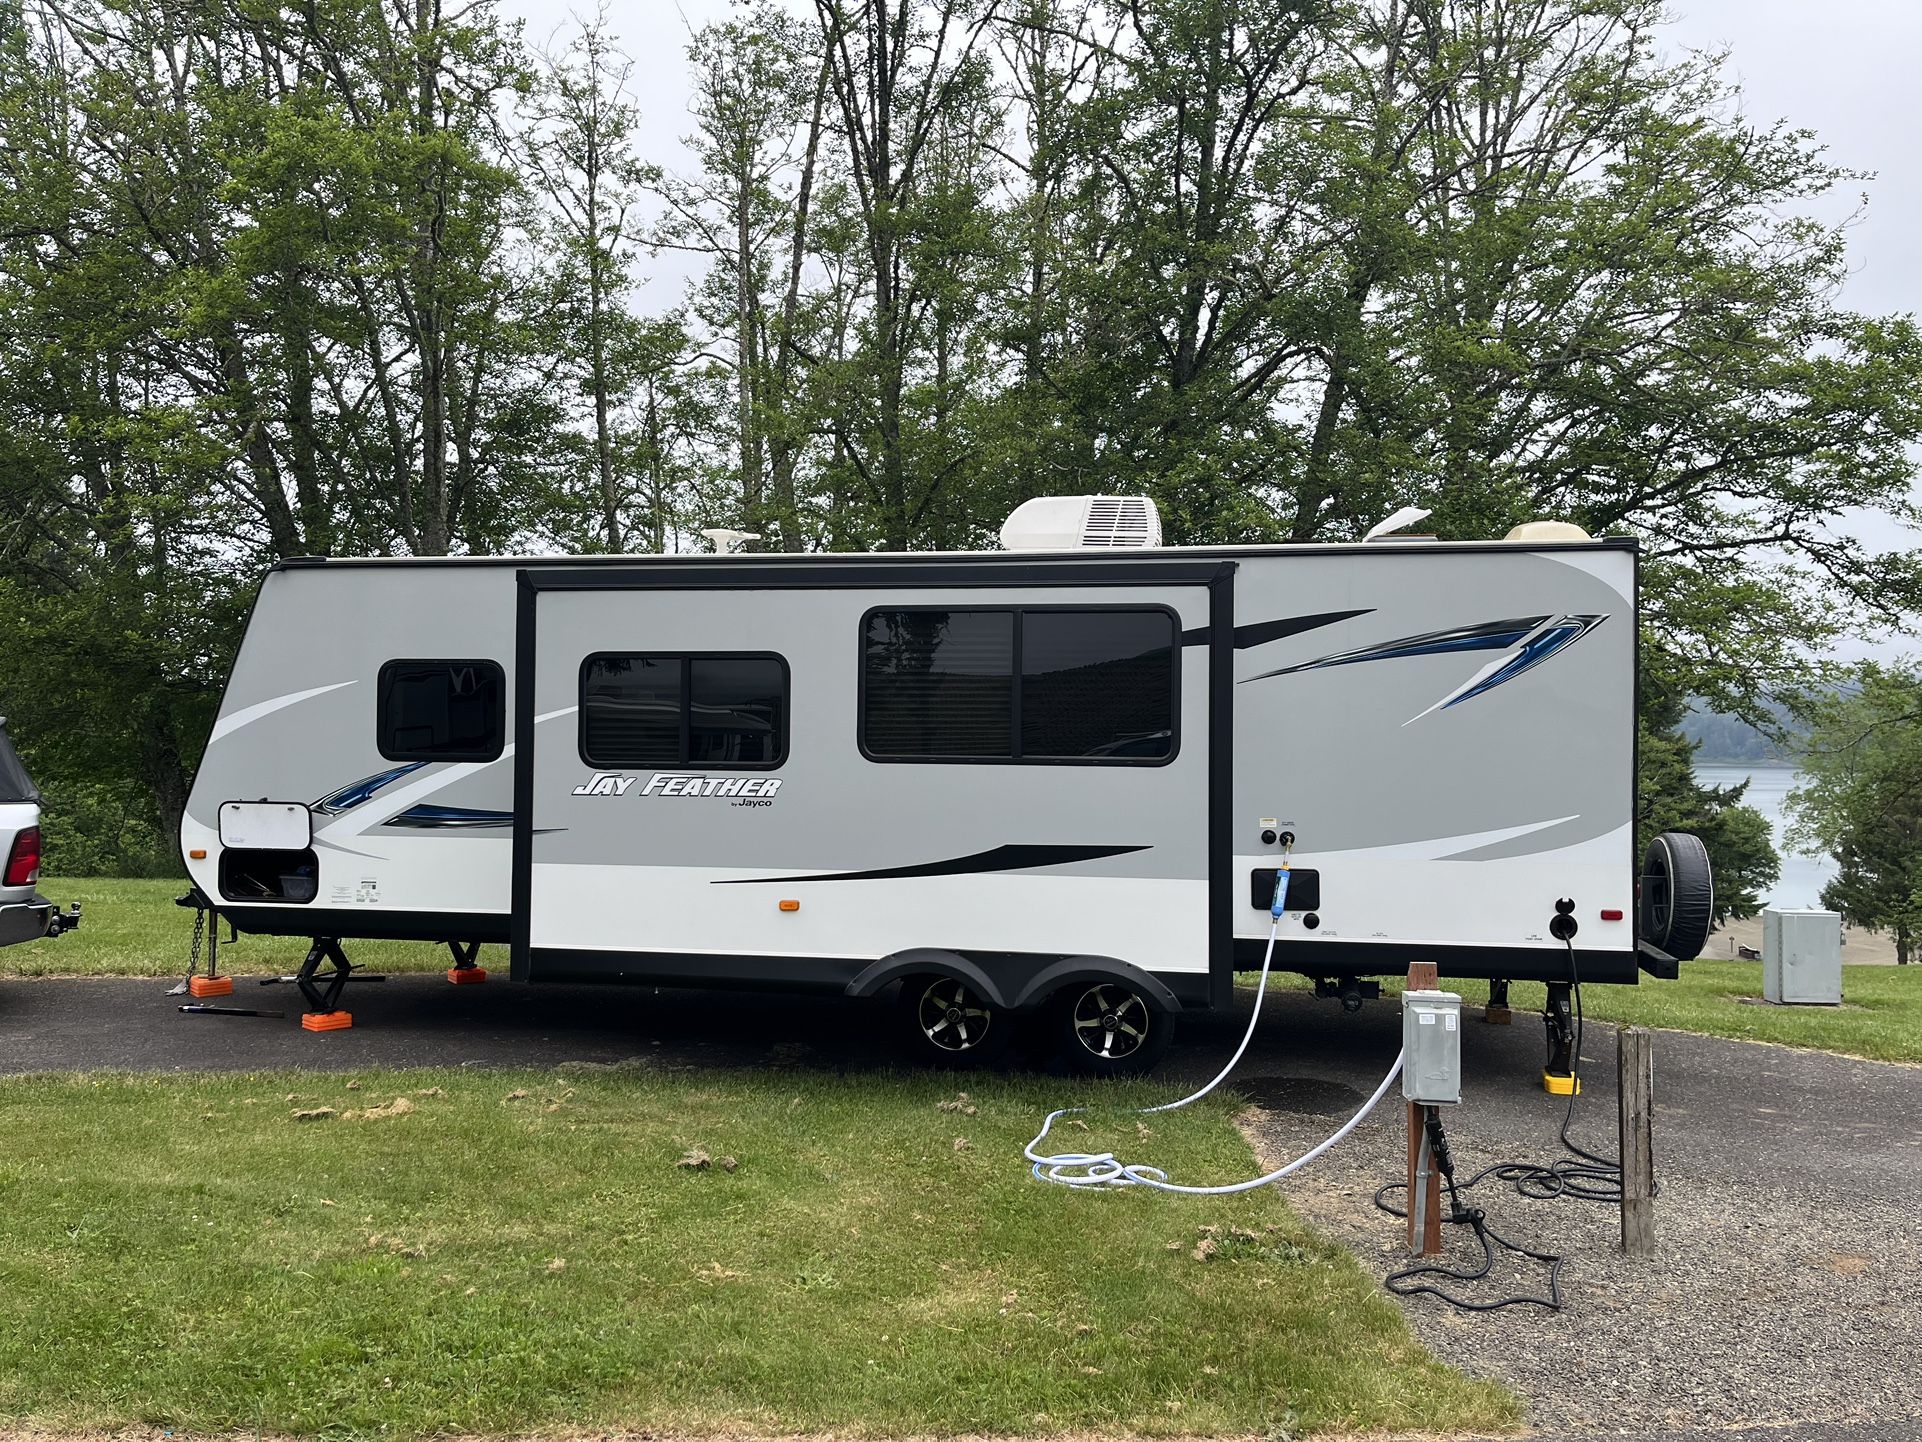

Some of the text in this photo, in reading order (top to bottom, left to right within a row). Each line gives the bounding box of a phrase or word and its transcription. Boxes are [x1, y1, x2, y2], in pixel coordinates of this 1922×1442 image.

[571, 772, 783, 797] JAY FEATHER
[738, 798, 772, 808] Jayco
